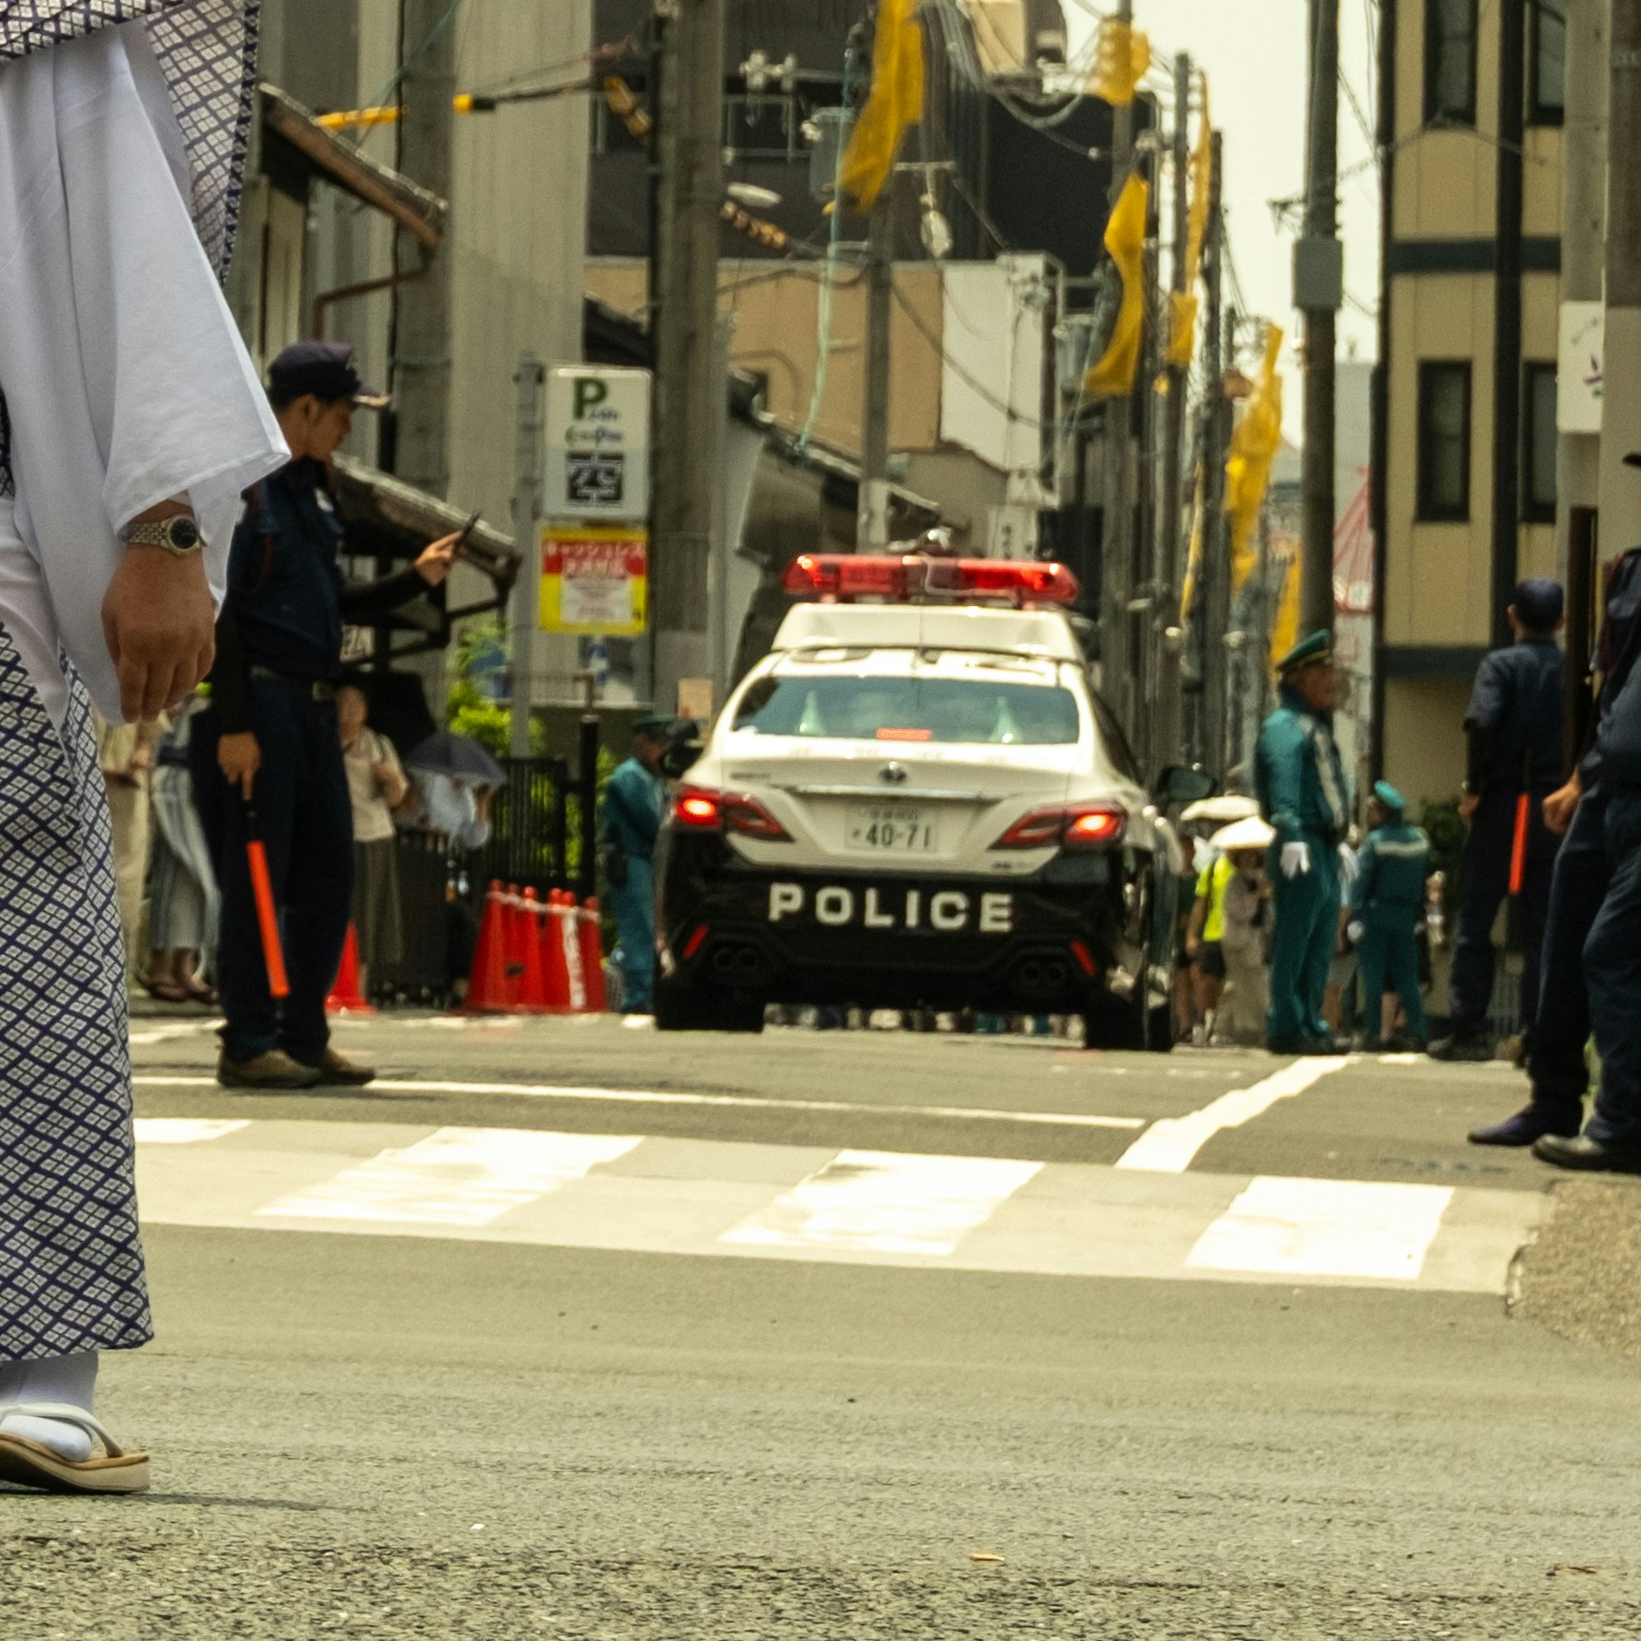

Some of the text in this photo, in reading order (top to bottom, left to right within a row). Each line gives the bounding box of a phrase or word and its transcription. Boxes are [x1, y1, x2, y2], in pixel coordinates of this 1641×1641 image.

[573, 376, 609, 421] P
[865, 821, 930, 848] 40-71
[767, 881, 1014, 933] POLICE
